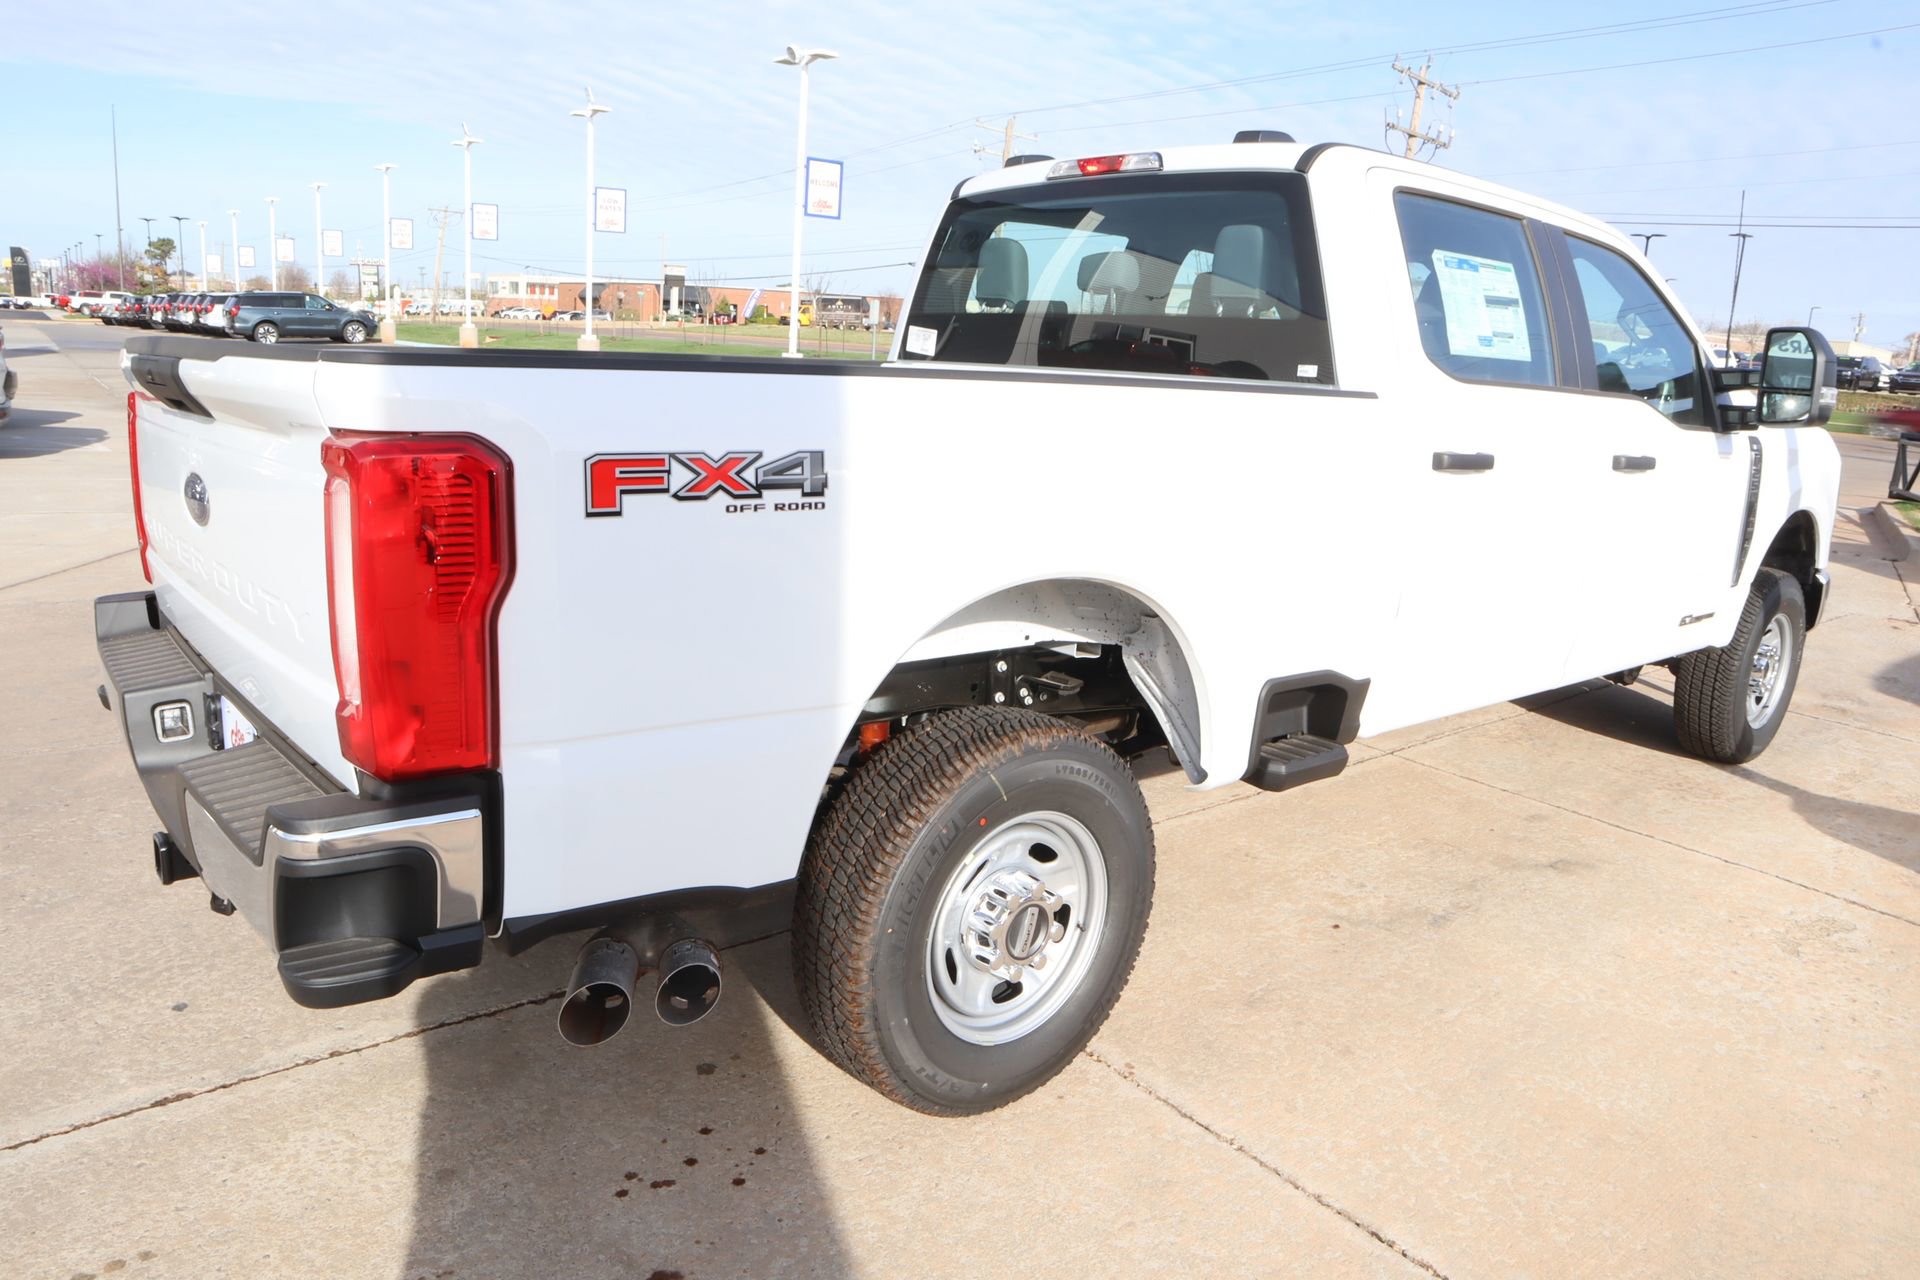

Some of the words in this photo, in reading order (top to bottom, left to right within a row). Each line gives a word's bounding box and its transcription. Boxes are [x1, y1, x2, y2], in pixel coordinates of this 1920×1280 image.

[584, 450, 828, 518] FX4
[725, 504, 767, 514] OFF
[774, 501, 826, 512] ROAD
